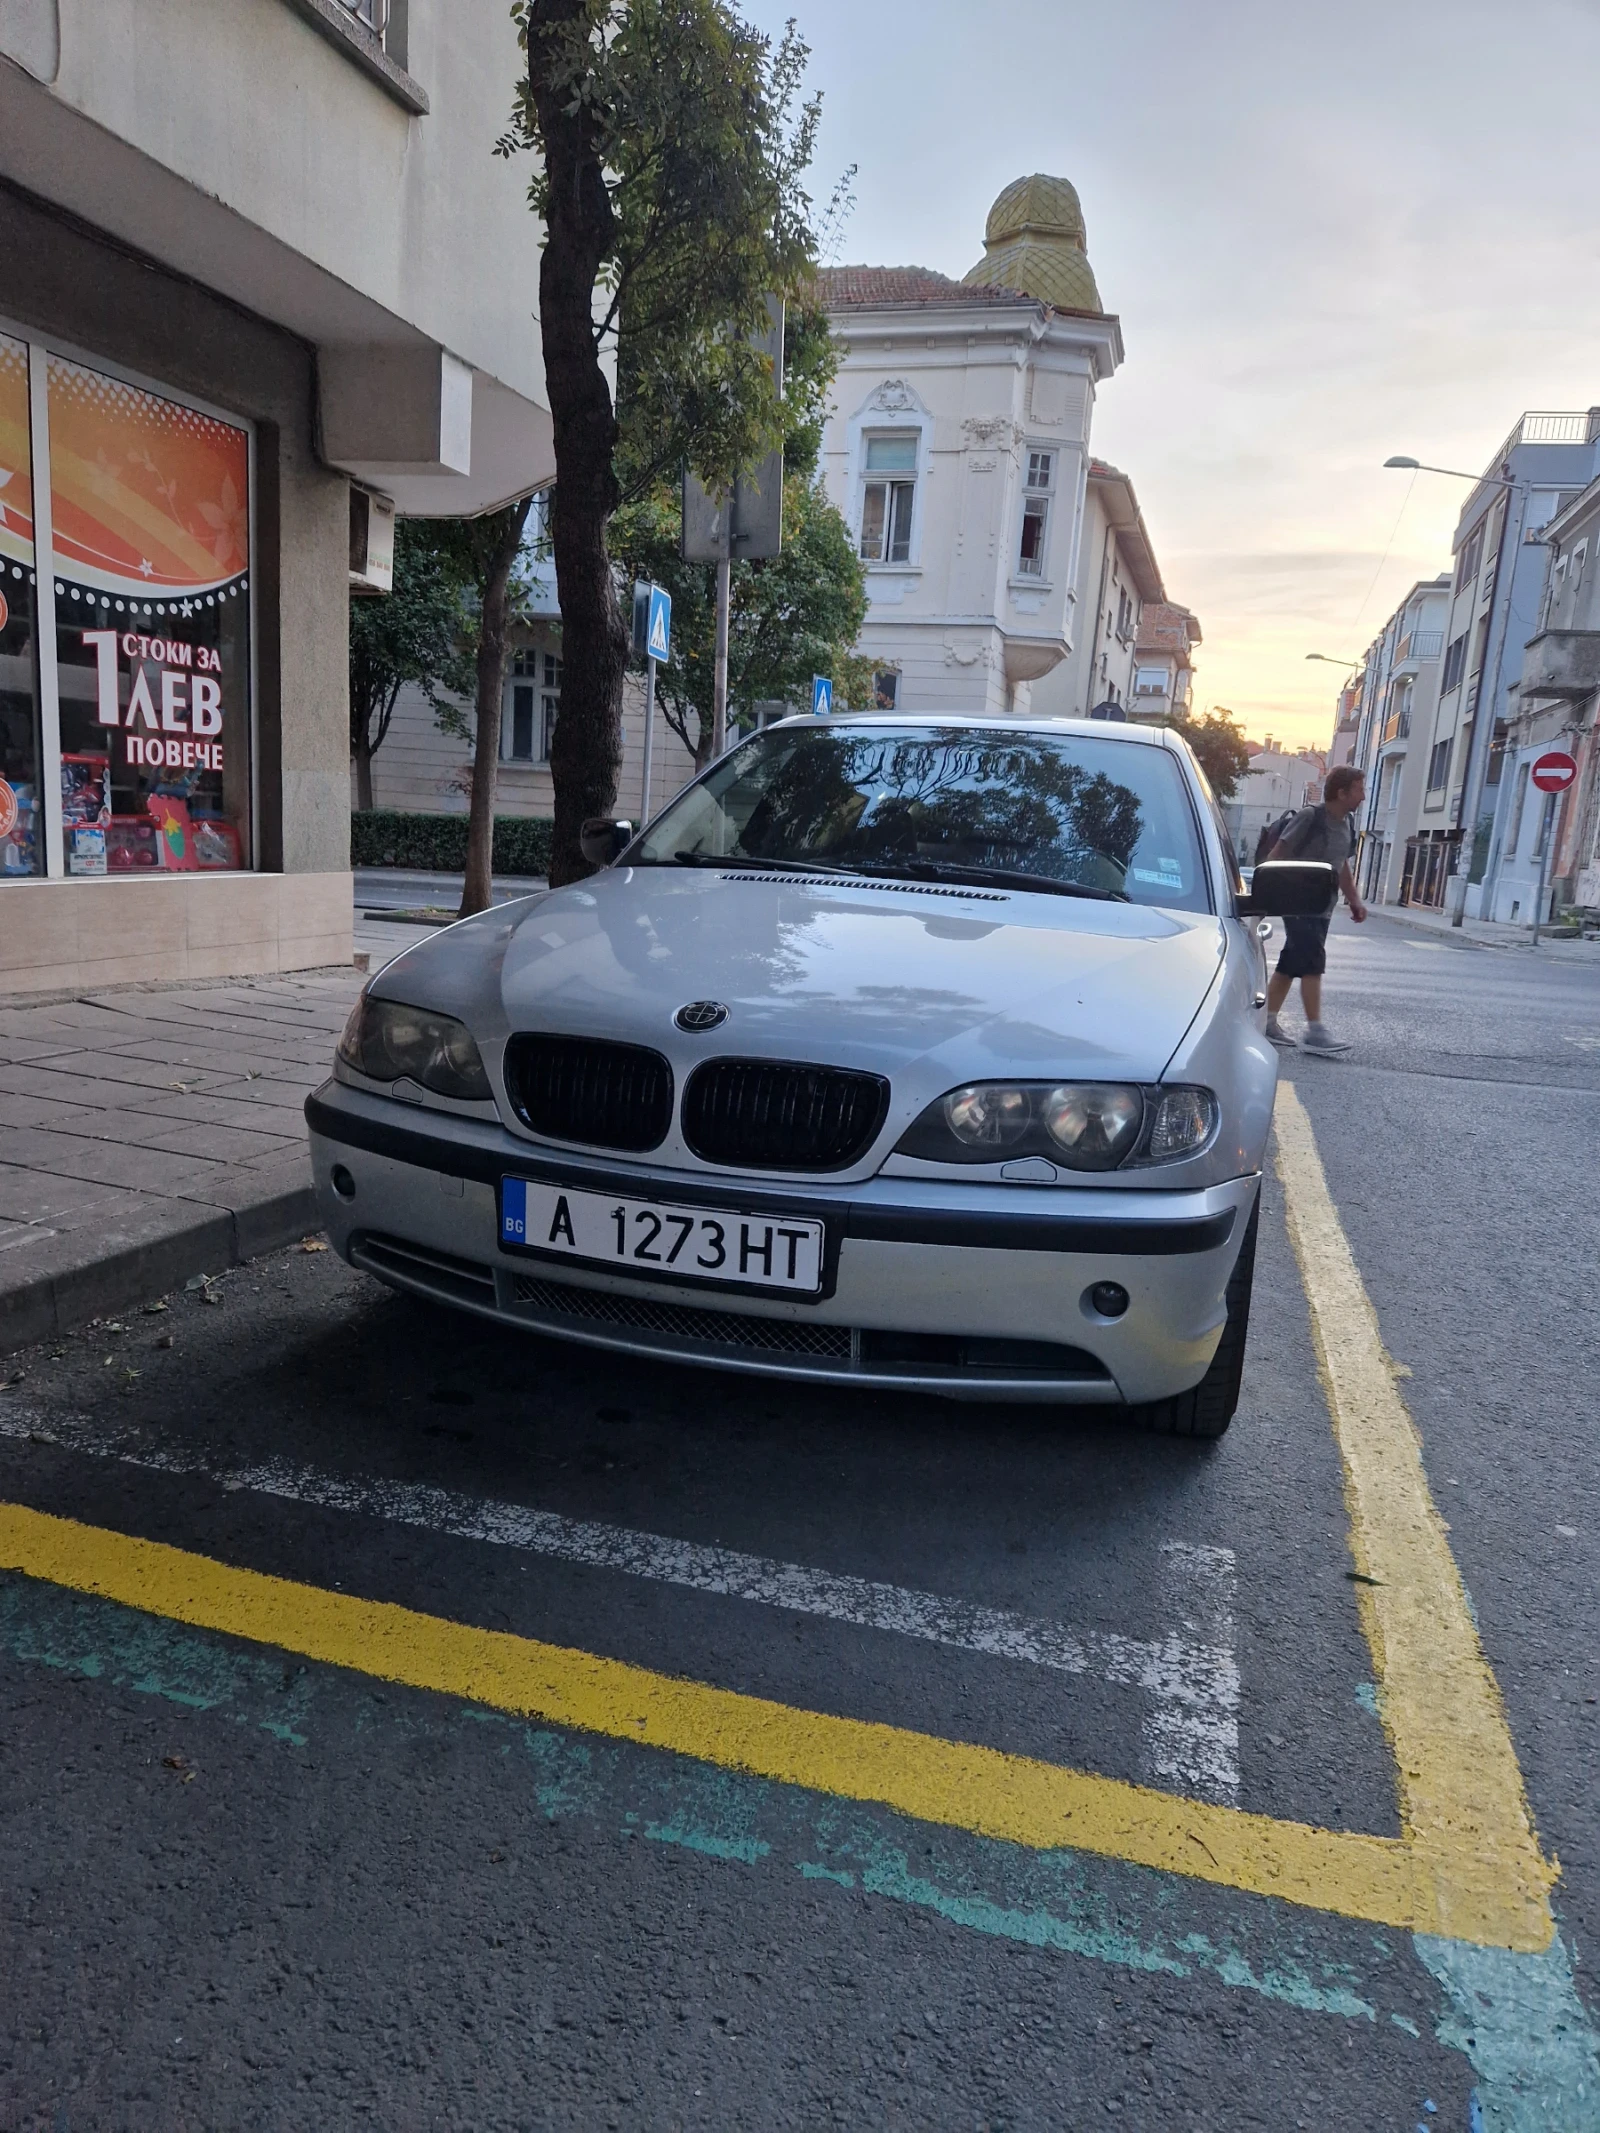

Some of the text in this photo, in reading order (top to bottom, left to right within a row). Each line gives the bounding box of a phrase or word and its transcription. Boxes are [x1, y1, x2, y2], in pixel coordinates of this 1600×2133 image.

[122, 633, 222, 672] СТОКИ ЗА
[82, 630, 118, 725] 1
[125, 664, 223, 735] ЛЕВ
[126, 735, 223, 770] ПОВЕЧЕ
[505, 1217, 525, 1234] BG
